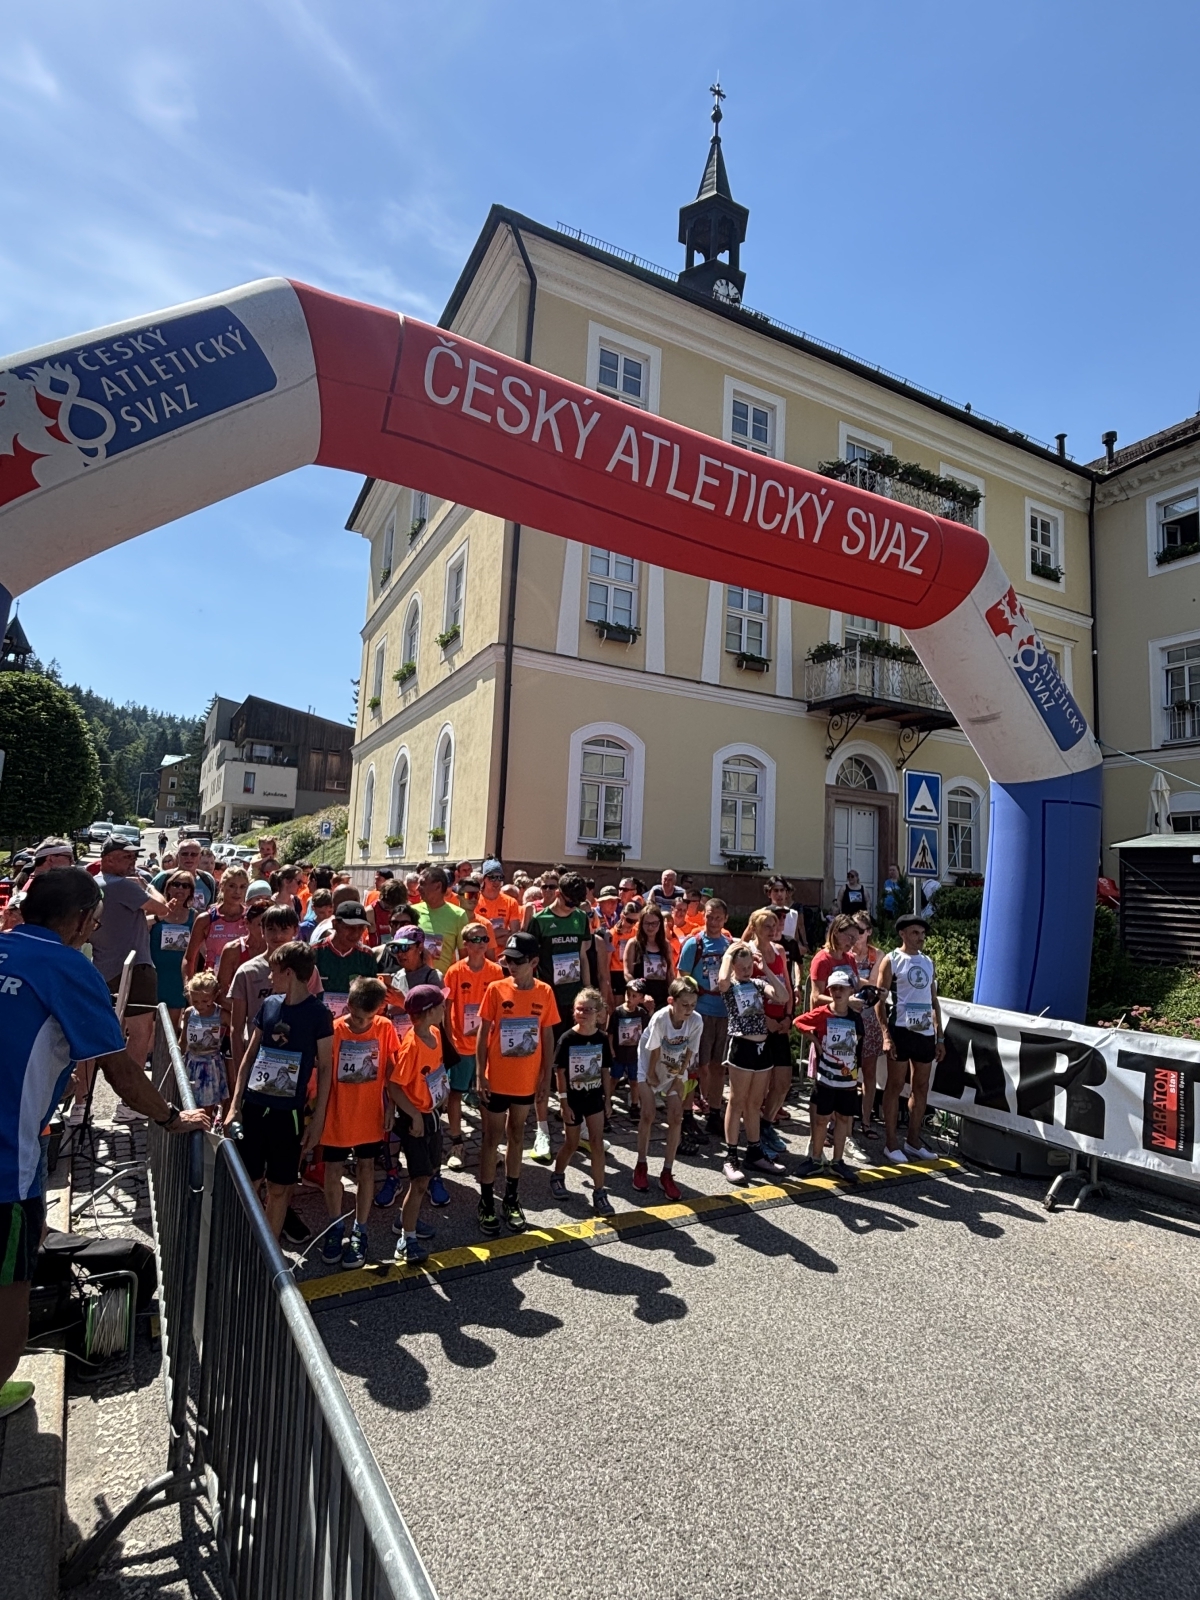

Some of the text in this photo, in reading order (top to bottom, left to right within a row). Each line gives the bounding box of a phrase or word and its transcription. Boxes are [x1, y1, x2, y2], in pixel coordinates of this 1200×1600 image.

[77, 326, 168, 371] ČESKÝ
[100, 325, 247, 401] ATLETICKÝ
[120, 383, 198, 433] SVAZ
[424, 335, 929, 575] ČESKÝ ATLETICKÝ SVAZ
[1028, 673, 1056, 711] SVAZ
[1040, 663, 1084, 735] ATLETICKÝ
[322, 822, 330, 832] P
[164, 936, 174, 944] 50
[508, 936, 517, 948] A
[552, 936, 579, 944] IRELAND
[557, 969, 566, 977] 40
[741, 999, 751, 1009] 32
[470, 1020, 475, 1028] 1
[908, 1017, 920, 1025] 116
[189, 1033, 198, 1042] 30
[621, 1032, 630, 1040] 83
[831, 1034, 841, 1042] 67
[508, 1038, 514, 1048] 5
[662, 1053, 676, 1064] 108
[342, 1062, 356, 1073] 44
[574, 1064, 585, 1073] 58
[255, 1071, 270, 1083] 39
[1151, 1068, 1168, 1147] MARATON
